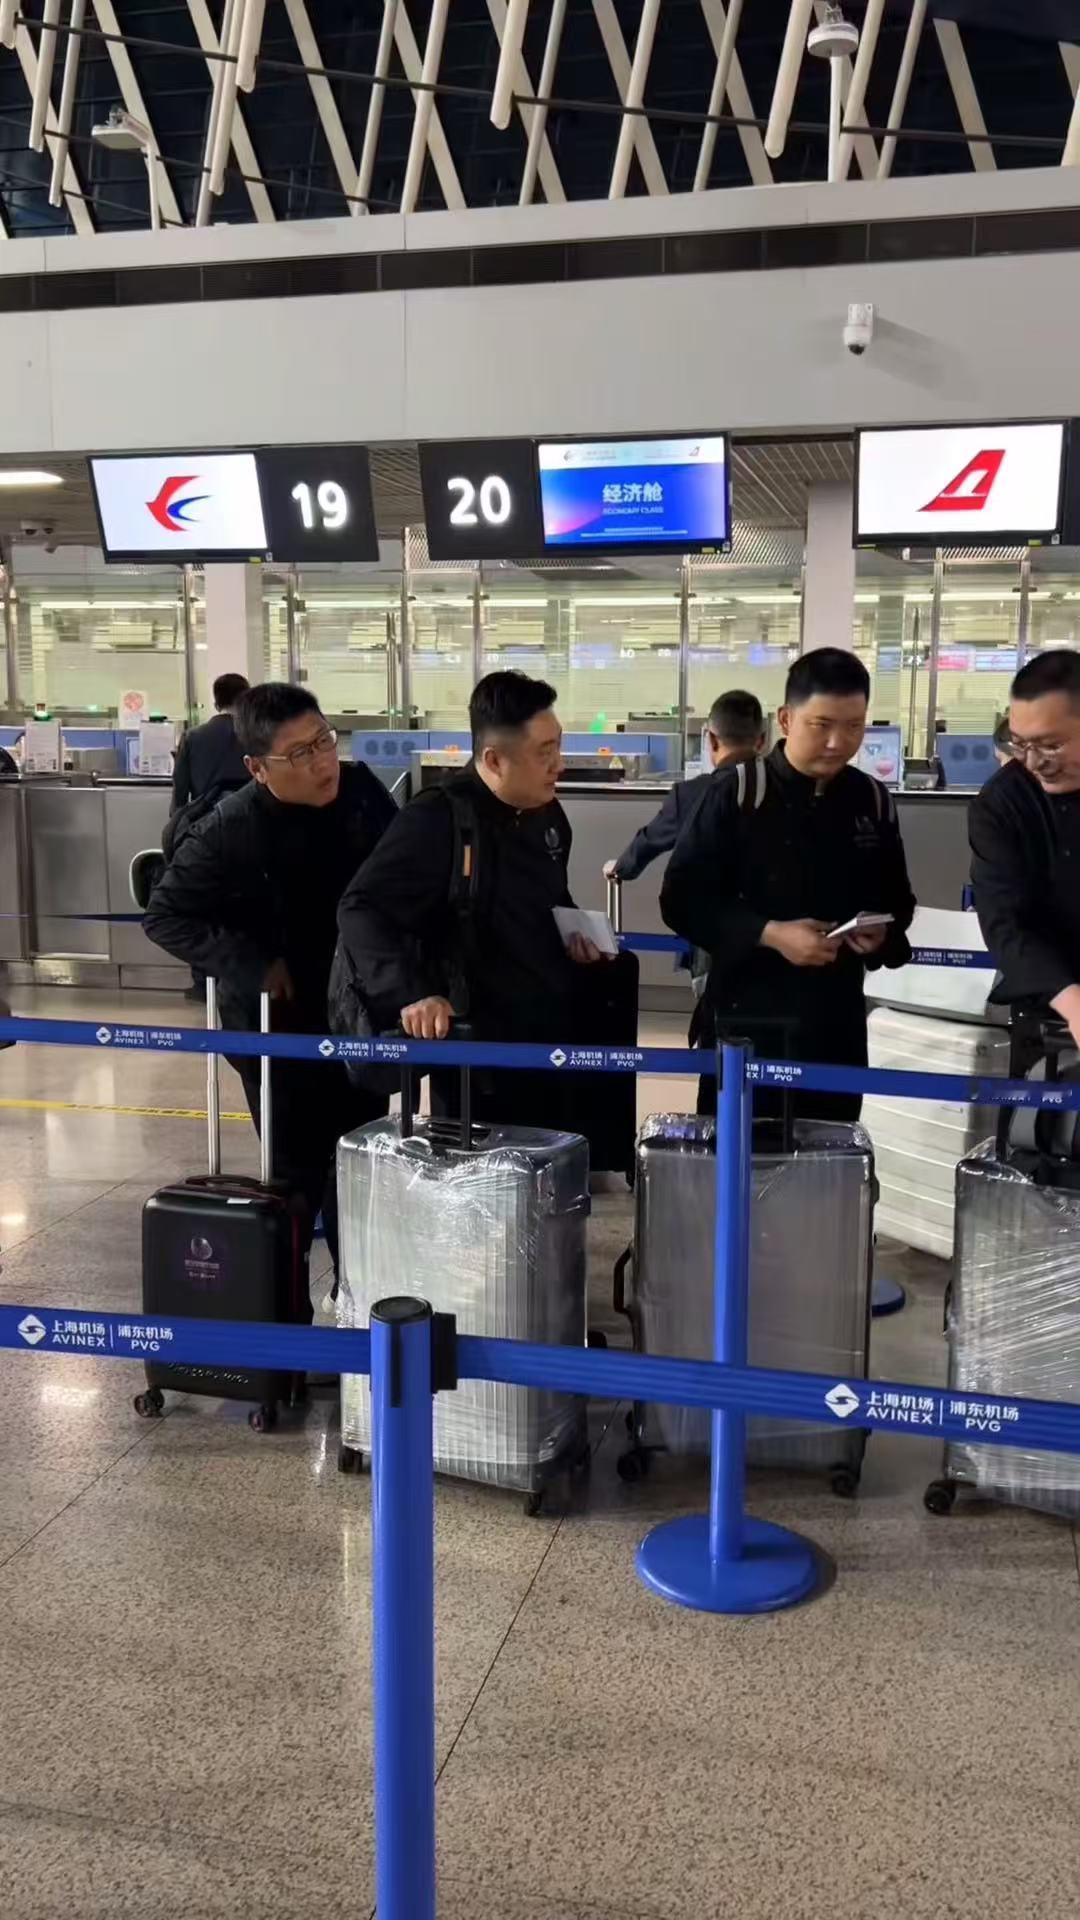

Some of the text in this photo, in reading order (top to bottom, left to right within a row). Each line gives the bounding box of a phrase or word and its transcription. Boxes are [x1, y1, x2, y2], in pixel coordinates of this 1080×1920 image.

[447, 475, 511, 524] 20
[602, 482, 663, 503] 经济舱
[292, 480, 348, 529] 19
[337, 1049, 369, 1057] AVINEX
[569, 1058, 603, 1067] AVINEX
[51, 1319, 174, 1341] 上海机场 浦东机场
[52, 1334, 161, 1352] AVINEX PVG
[866, 1390, 1020, 1422] 上海机场 浦东机场
[866, 1407, 1002, 1433] AVINEX PVG
